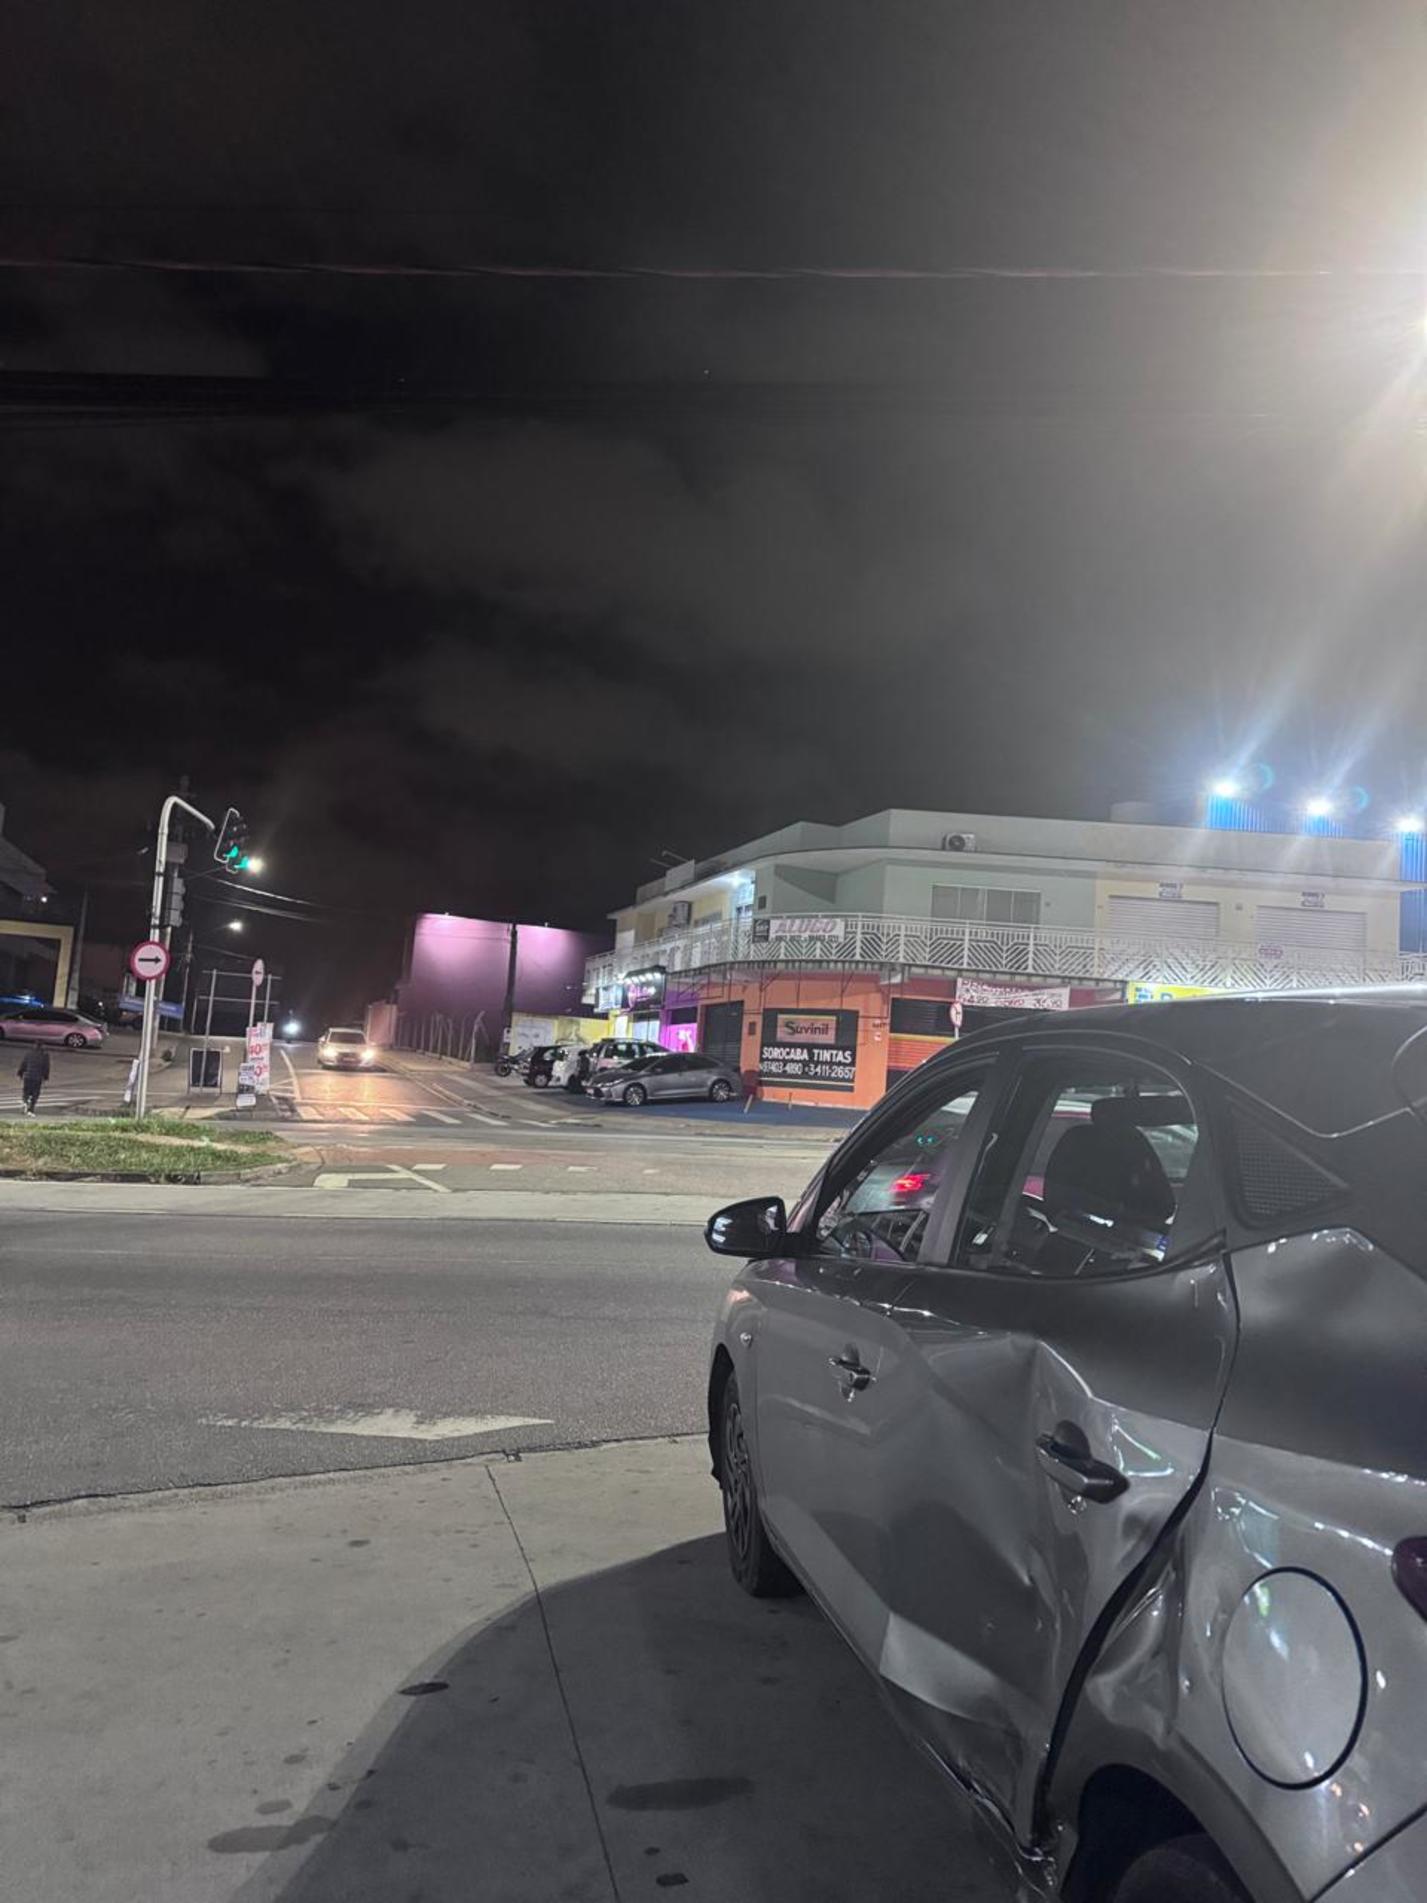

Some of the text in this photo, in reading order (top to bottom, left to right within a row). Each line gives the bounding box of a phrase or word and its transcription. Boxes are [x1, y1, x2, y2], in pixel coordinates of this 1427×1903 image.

[784, 1021, 829, 1036] Suvinil
[761, 1046, 853, 1063] SOROCABA TINTAS
